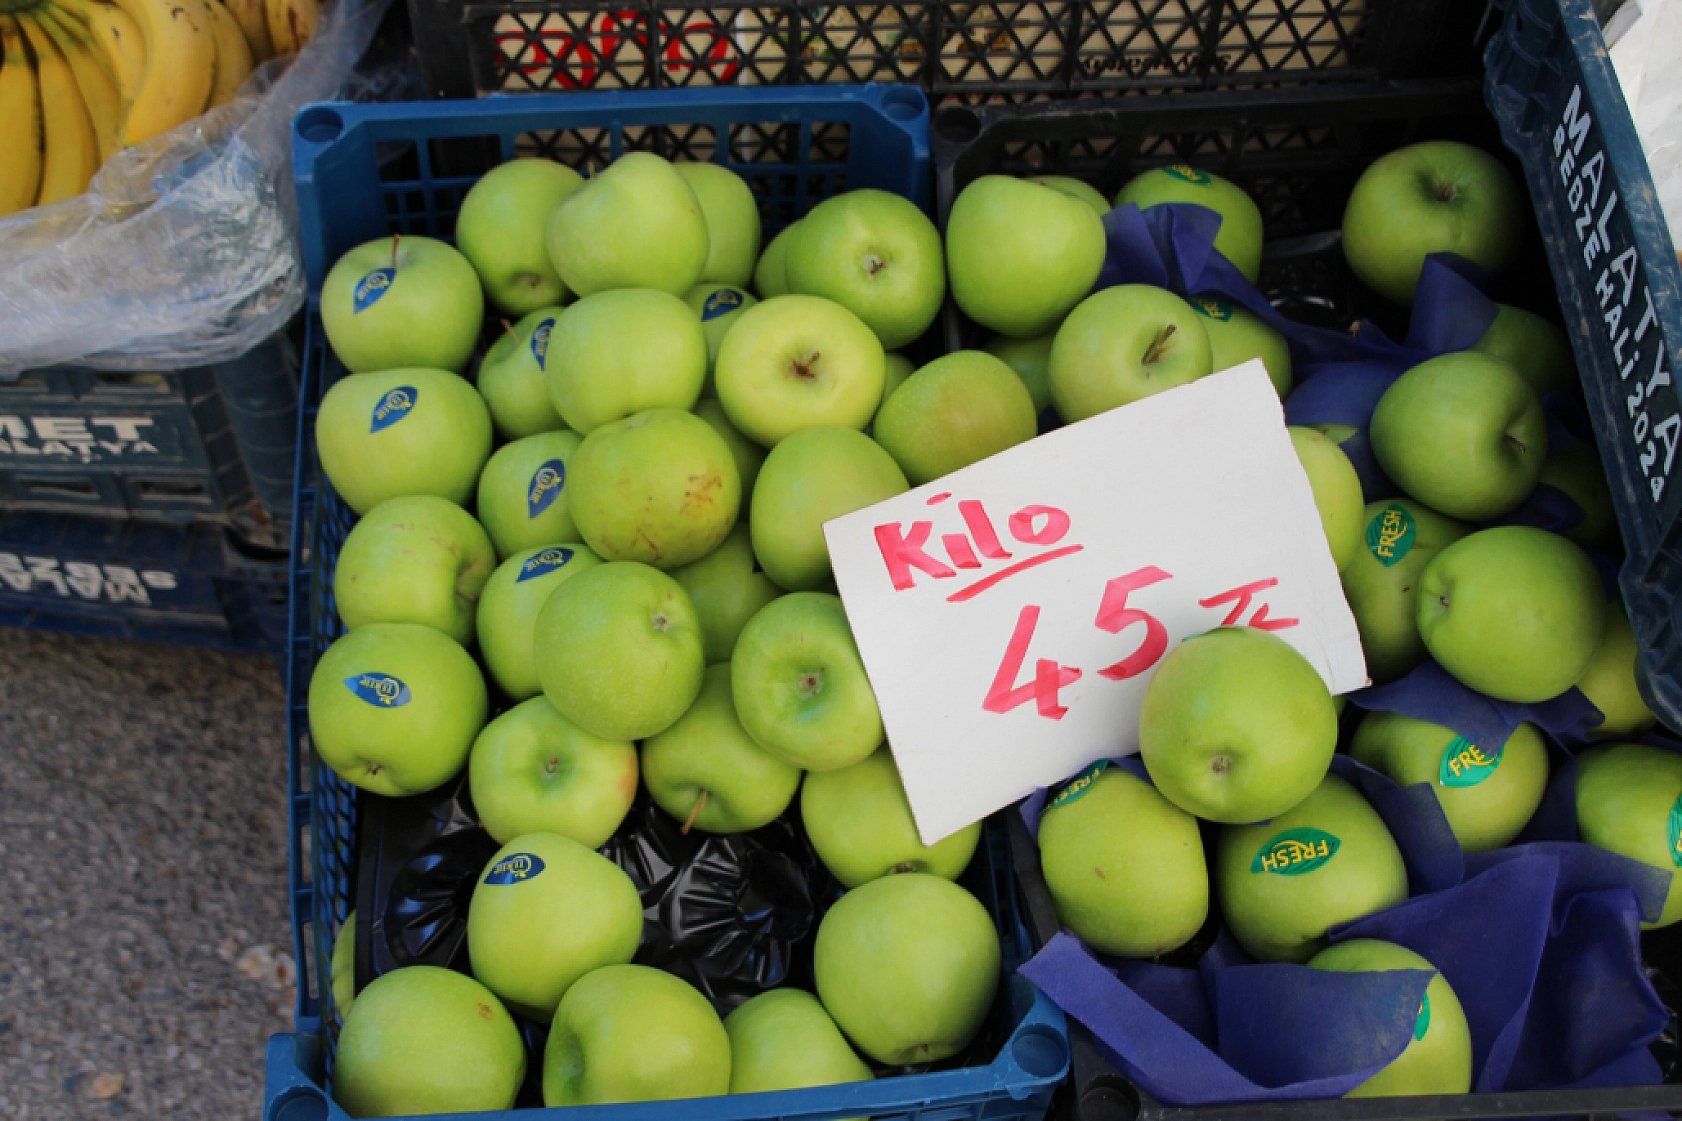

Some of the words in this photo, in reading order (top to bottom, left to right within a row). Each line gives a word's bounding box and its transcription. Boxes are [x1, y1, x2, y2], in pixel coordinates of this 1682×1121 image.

[1563, 84, 1681, 476] MALATYA
[874, 492, 1071, 591] Kilo
[1378, 510, 1407, 557] FRESH
[982, 565, 1174, 720] 45
[1449, 744, 1497, 777] FRE
[1261, 839, 1329, 872] FRESH
